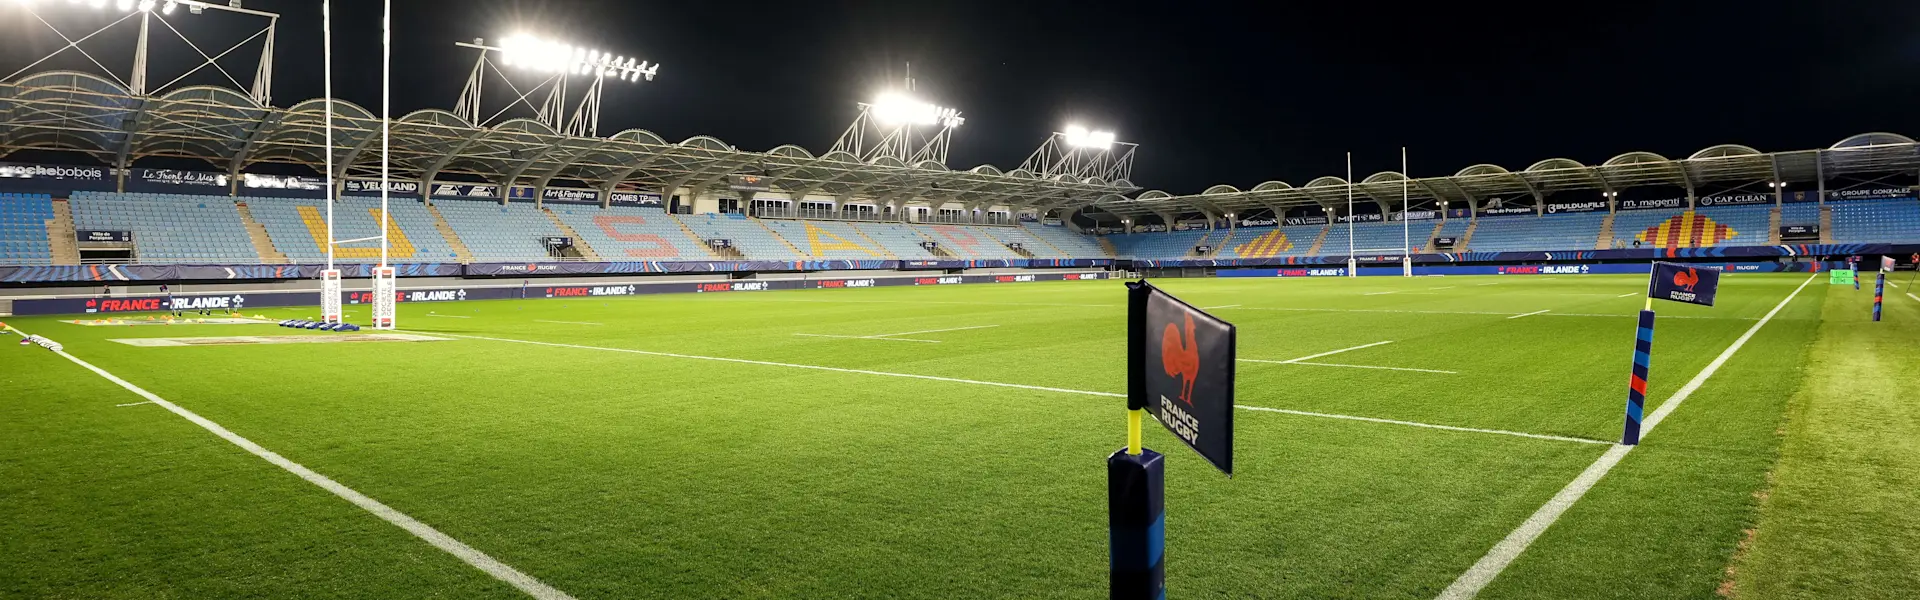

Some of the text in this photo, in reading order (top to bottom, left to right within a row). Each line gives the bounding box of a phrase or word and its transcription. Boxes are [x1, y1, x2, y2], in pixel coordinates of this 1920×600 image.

[142, 169, 155, 180] Le
[156, 169, 183, 181] Front
[183, 171, 196, 181] de
[1841, 189, 1871, 197] GROUPE
[1872, 187, 1912, 195] GONZALEZ
[611, 193, 638, 202] COMES
[1735, 195, 1767, 203] CLEAN
[1505, 206, 1531, 214] Perpignan
[411, 291, 456, 301] IRLANDE
[554, 288, 588, 296] FRANCE
[593, 286, 627, 295] IRLANDE
[101, 299, 160, 311] FRANCE
[170, 297, 229, 309] IRLANDE
[1160, 394, 1199, 432] FRANCE
[1161, 407, 1198, 445] RUGBY
